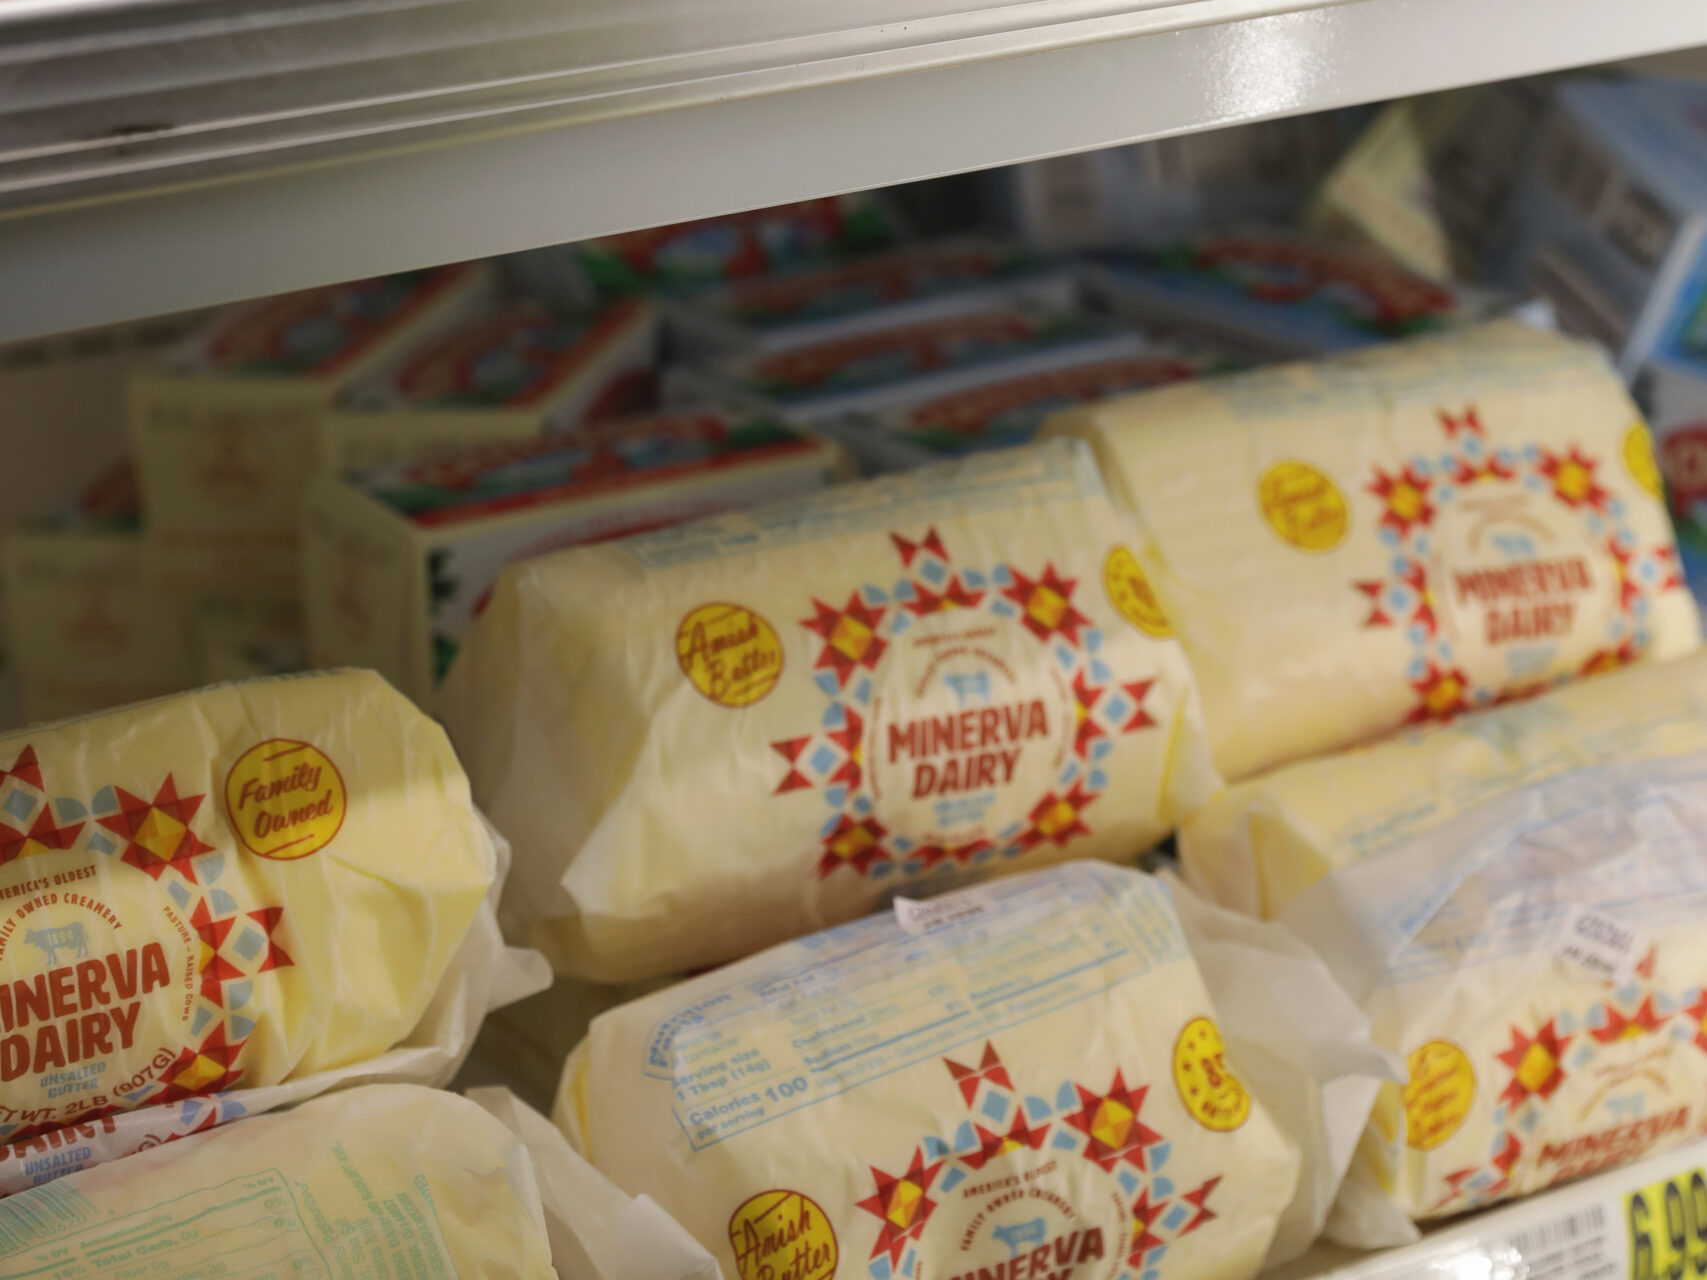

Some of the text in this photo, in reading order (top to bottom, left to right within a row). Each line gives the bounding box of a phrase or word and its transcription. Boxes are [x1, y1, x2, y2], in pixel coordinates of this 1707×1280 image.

[888, 699, 1049, 766] MINERVA
[238, 762, 322, 811] Family
[913, 747, 1021, 800] DAIRY
[253, 789, 334, 838] Owned
[0, 942, 171, 1034] INERVA
[0, 1001, 141, 1083] DAIRY
[20, 1108, 57, 1122] WT.
[64, 1096, 109, 1116] 2LB
[112, 1047, 177, 1097] (907G)
[39, 1062, 106, 1088] UNSALTED
[47, 1080, 99, 1099] BUTTER
[690, 1076, 728, 1095] Tbsp
[689, 1076, 808, 1125] Calories 100
[697, 1107, 765, 1140] per serving
[25, 1146, 91, 1175] UNSALTED
[738, 1198, 811, 1276] Amish
